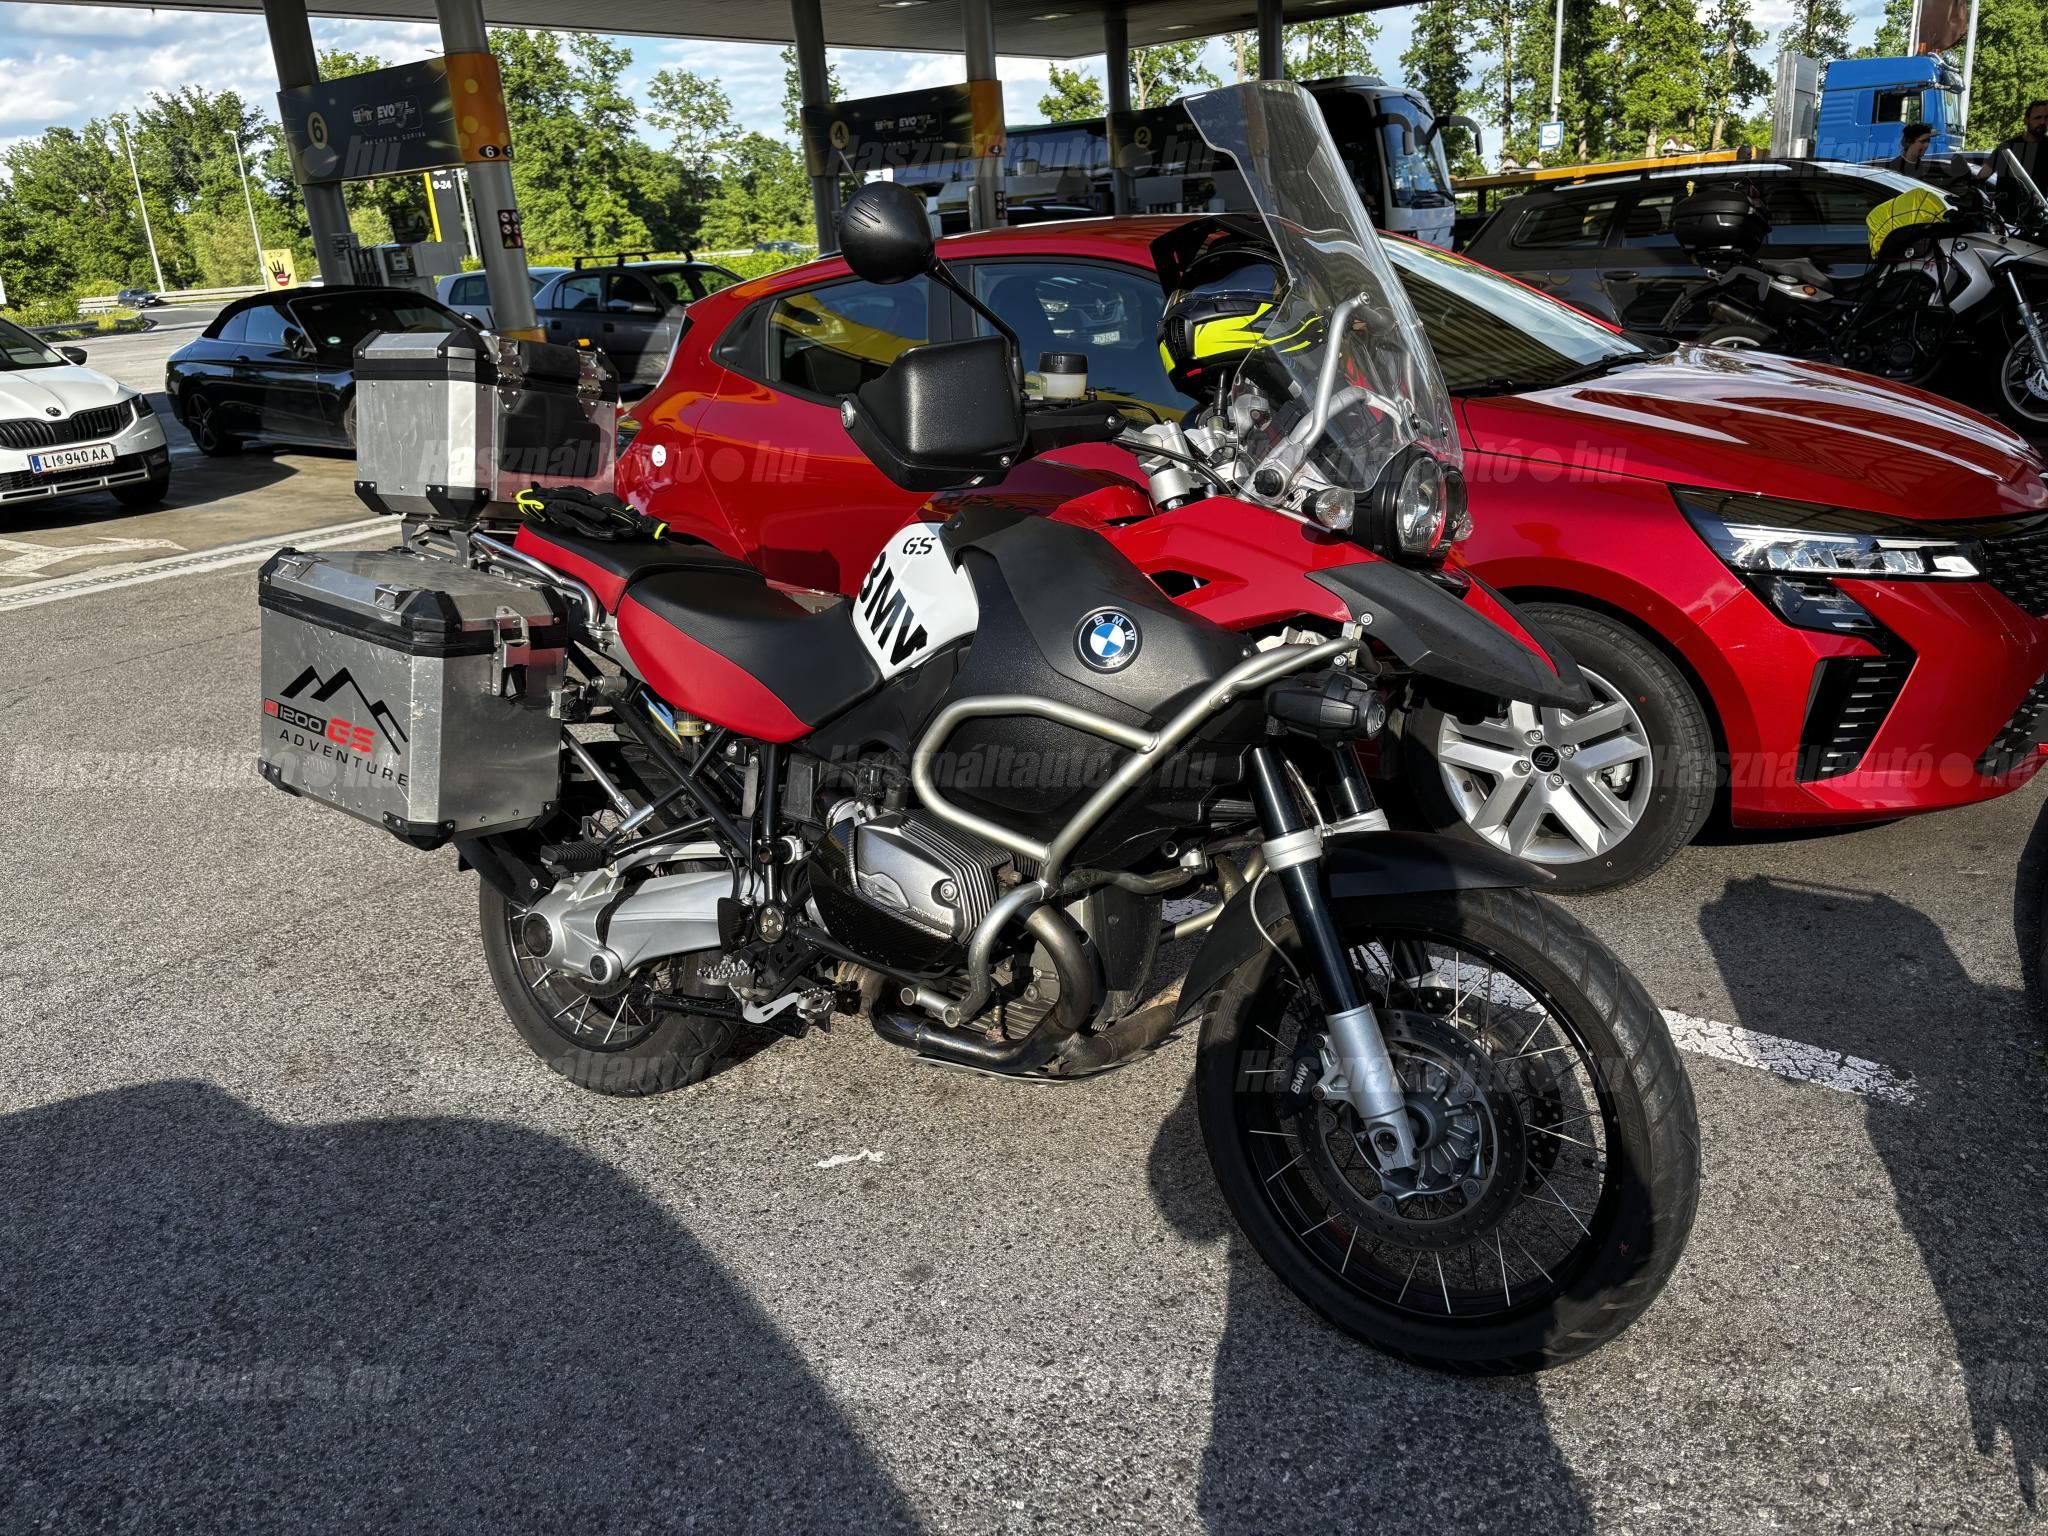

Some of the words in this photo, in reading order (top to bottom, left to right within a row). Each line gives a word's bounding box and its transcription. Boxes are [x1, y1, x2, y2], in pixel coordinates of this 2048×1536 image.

[376, 104, 396, 119] EVO
[311, 116, 323, 142] 6
[834, 125, 845, 144] 4
[1138, 130, 1148, 145] 2
[486, 146, 495, 158] 6
[43, 454, 56, 468] LI
[66, 450, 89, 465] 940
[92, 449, 109, 462] AA
[902, 537, 937, 555] GS
[1093, 615, 1135, 641] BMW
[326, 718, 376, 753] GS
[280, 729, 409, 787] ADVENTURE
[1290, 1062, 1310, 1095] BMW
